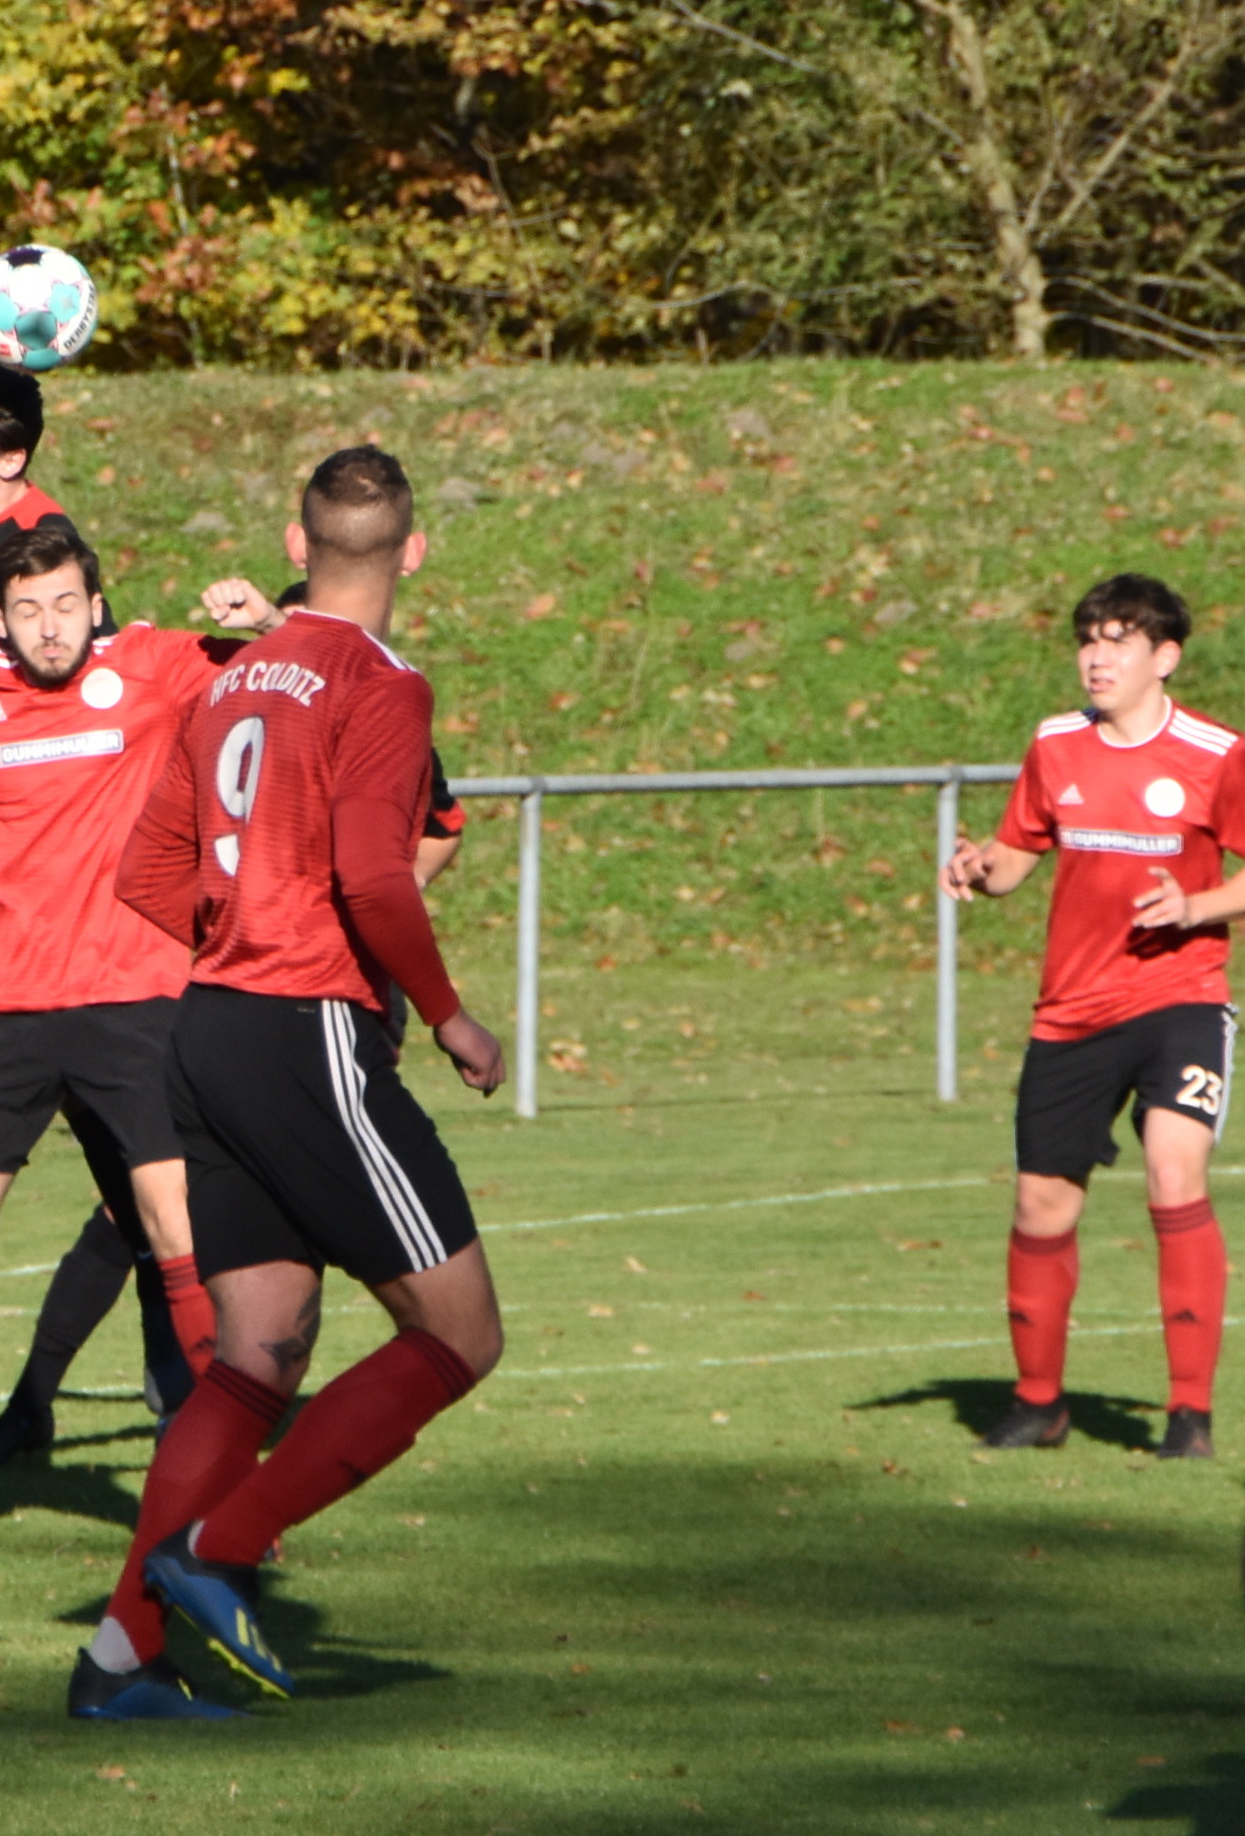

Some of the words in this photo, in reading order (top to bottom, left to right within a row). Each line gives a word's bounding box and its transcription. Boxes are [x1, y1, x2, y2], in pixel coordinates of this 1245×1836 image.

[63, 284, 95, 350] DERBYSTAR
[246, 661, 326, 707] COLDITZ
[215, 715, 265, 877] 9
[1175, 1063, 1223, 1116] 23
